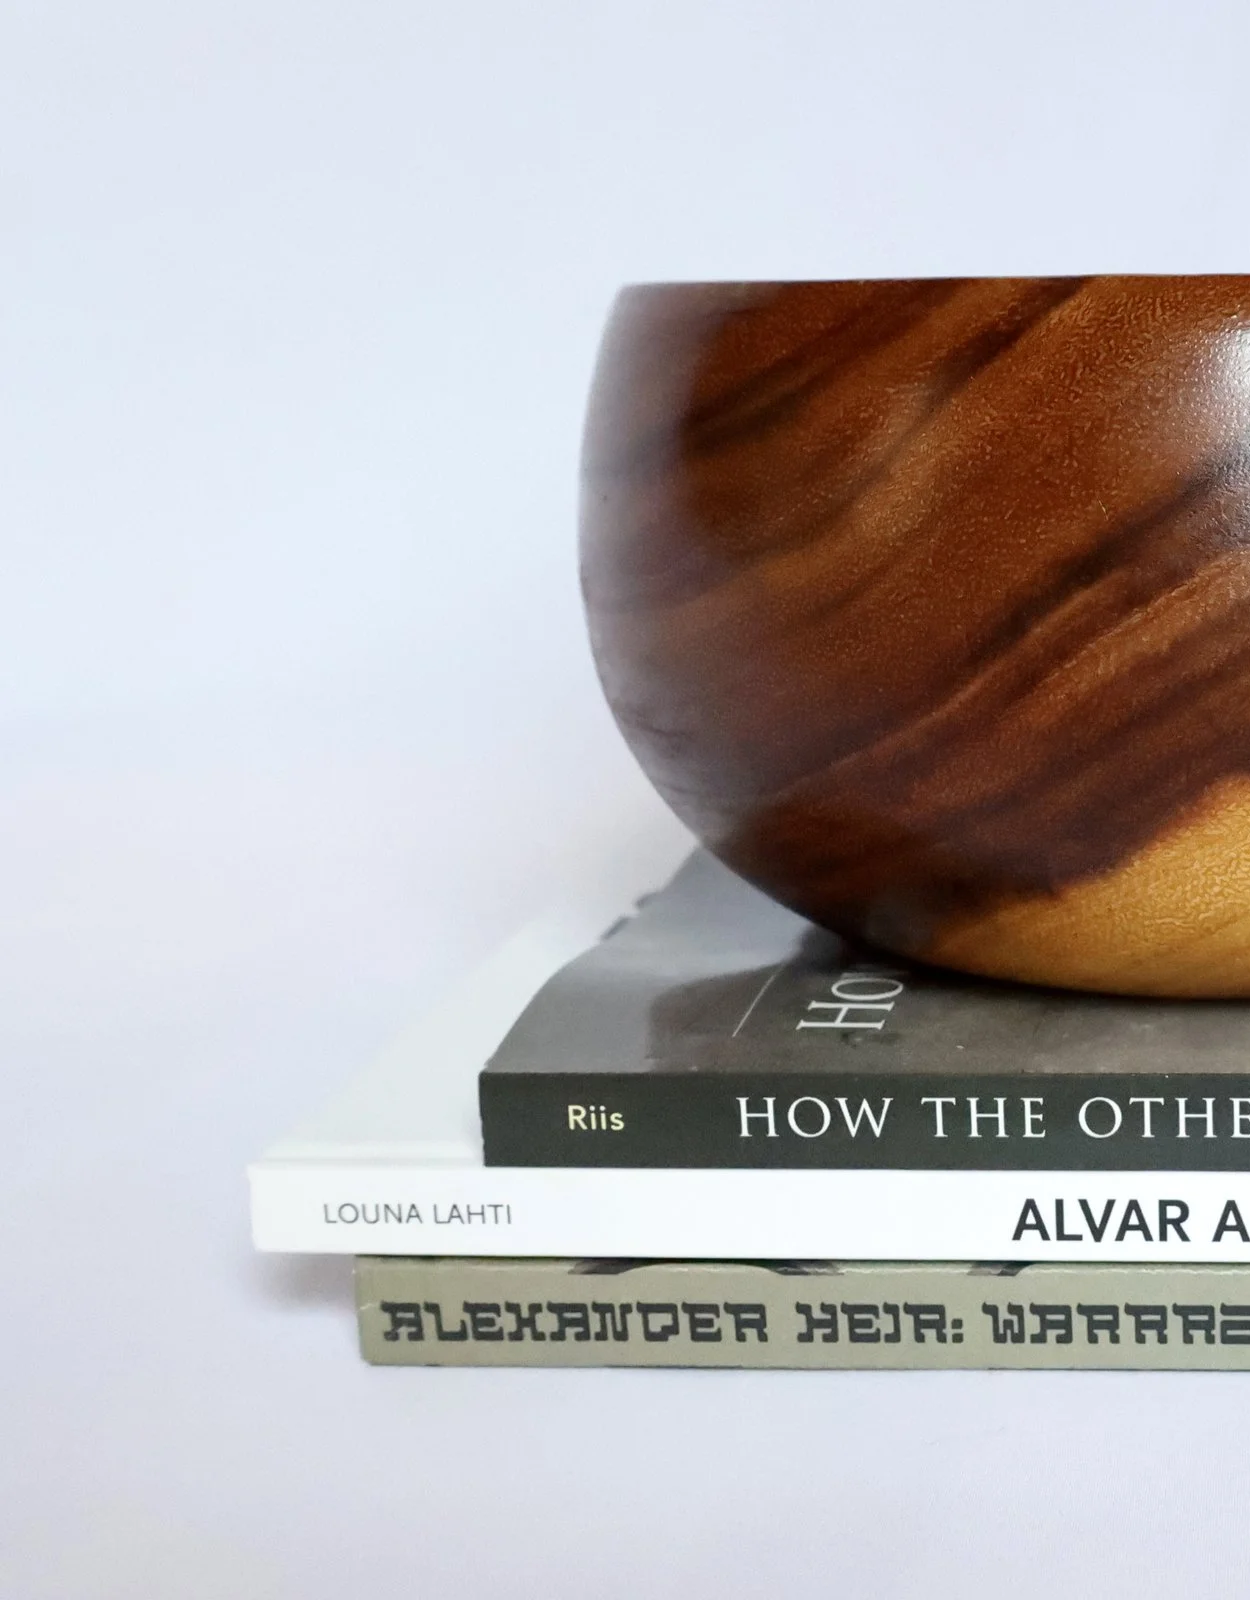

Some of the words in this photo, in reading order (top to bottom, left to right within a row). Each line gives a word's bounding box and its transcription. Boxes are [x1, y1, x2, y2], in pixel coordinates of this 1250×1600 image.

[796, 971, 906, 1030] HO
[567, 1104, 625, 1131] Riis
[735, 1096, 894, 1138] HOW
[920, 1096, 1046, 1139] THE
[323, 1202, 423, 1225] LOUNA
[432, 1203, 513, 1226] LAHTI
[1011, 1197, 1192, 1243] ALVAR
[380, 1301, 769, 1343] ALEXANDER
[794, 1301, 964, 1344] HEIR:
